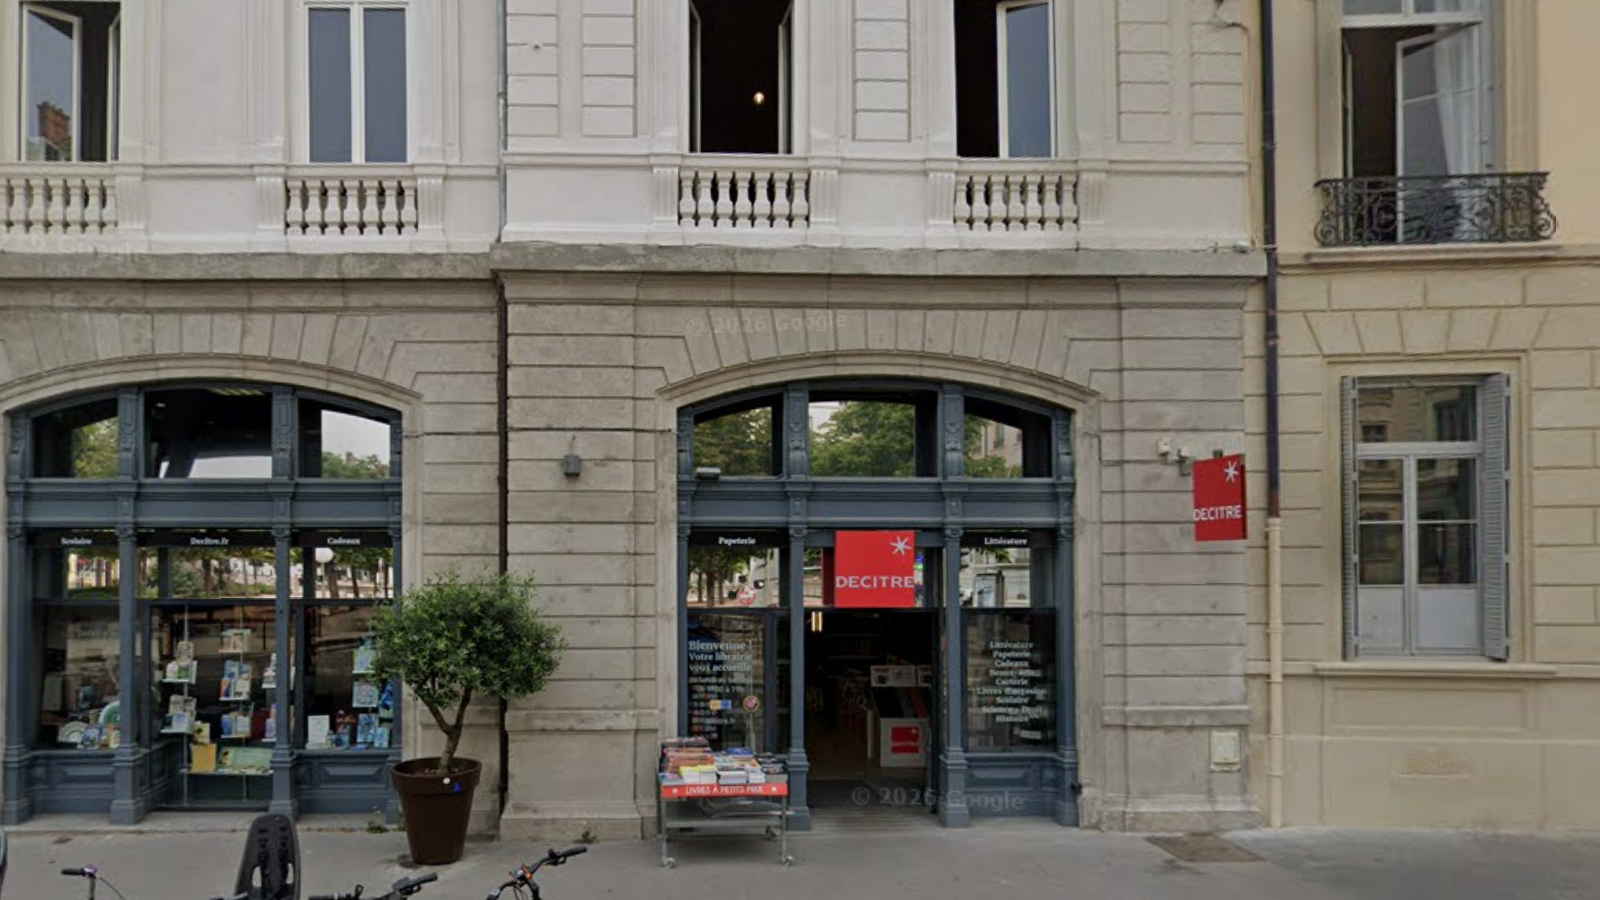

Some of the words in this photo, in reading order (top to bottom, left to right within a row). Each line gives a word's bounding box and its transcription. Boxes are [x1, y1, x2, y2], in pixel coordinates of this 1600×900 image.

[1193, 505, 1242, 520] DECITRE
[327, 536, 361, 545] Cadeaux
[718, 537, 756, 547] Papeterie
[835, 576, 915, 589] DECITRE
[688, 640, 746, 650] Bienvenue
[689, 652, 714, 661] Votre
[715, 651, 752, 661] librairie
[992, 650, 1031, 660] Papeterie
[689, 664, 711, 672] vous
[712, 662, 752, 672] accueille
[994, 659, 1029, 667] Cadeaux
[686, 785, 711, 795] LIVRES
[720, 785, 745, 794] PETITS
